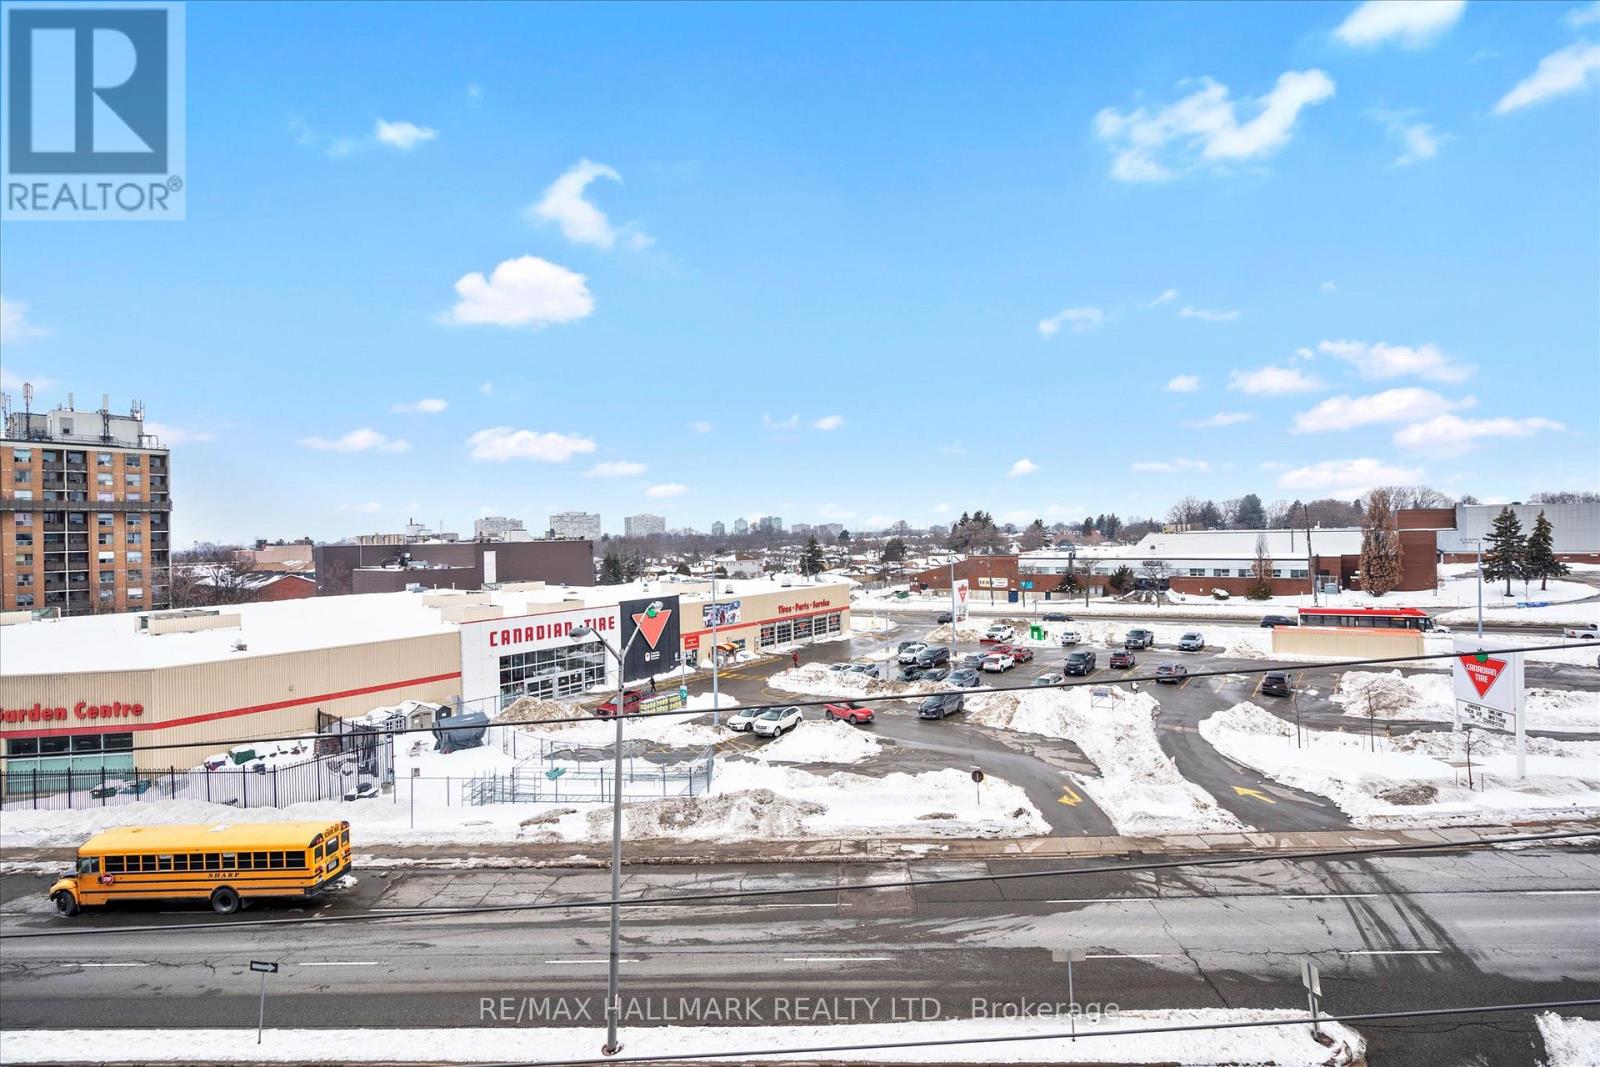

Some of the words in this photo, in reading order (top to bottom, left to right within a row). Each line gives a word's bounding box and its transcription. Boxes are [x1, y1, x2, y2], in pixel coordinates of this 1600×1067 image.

[489, 621, 573, 647] CANADIAN
[584, 615, 615, 632] TIRE
[1466, 663, 1497, 676] CANADIAN
[1474, 673, 1488, 683] TIRE
[74, 700, 144, 720] Centre
